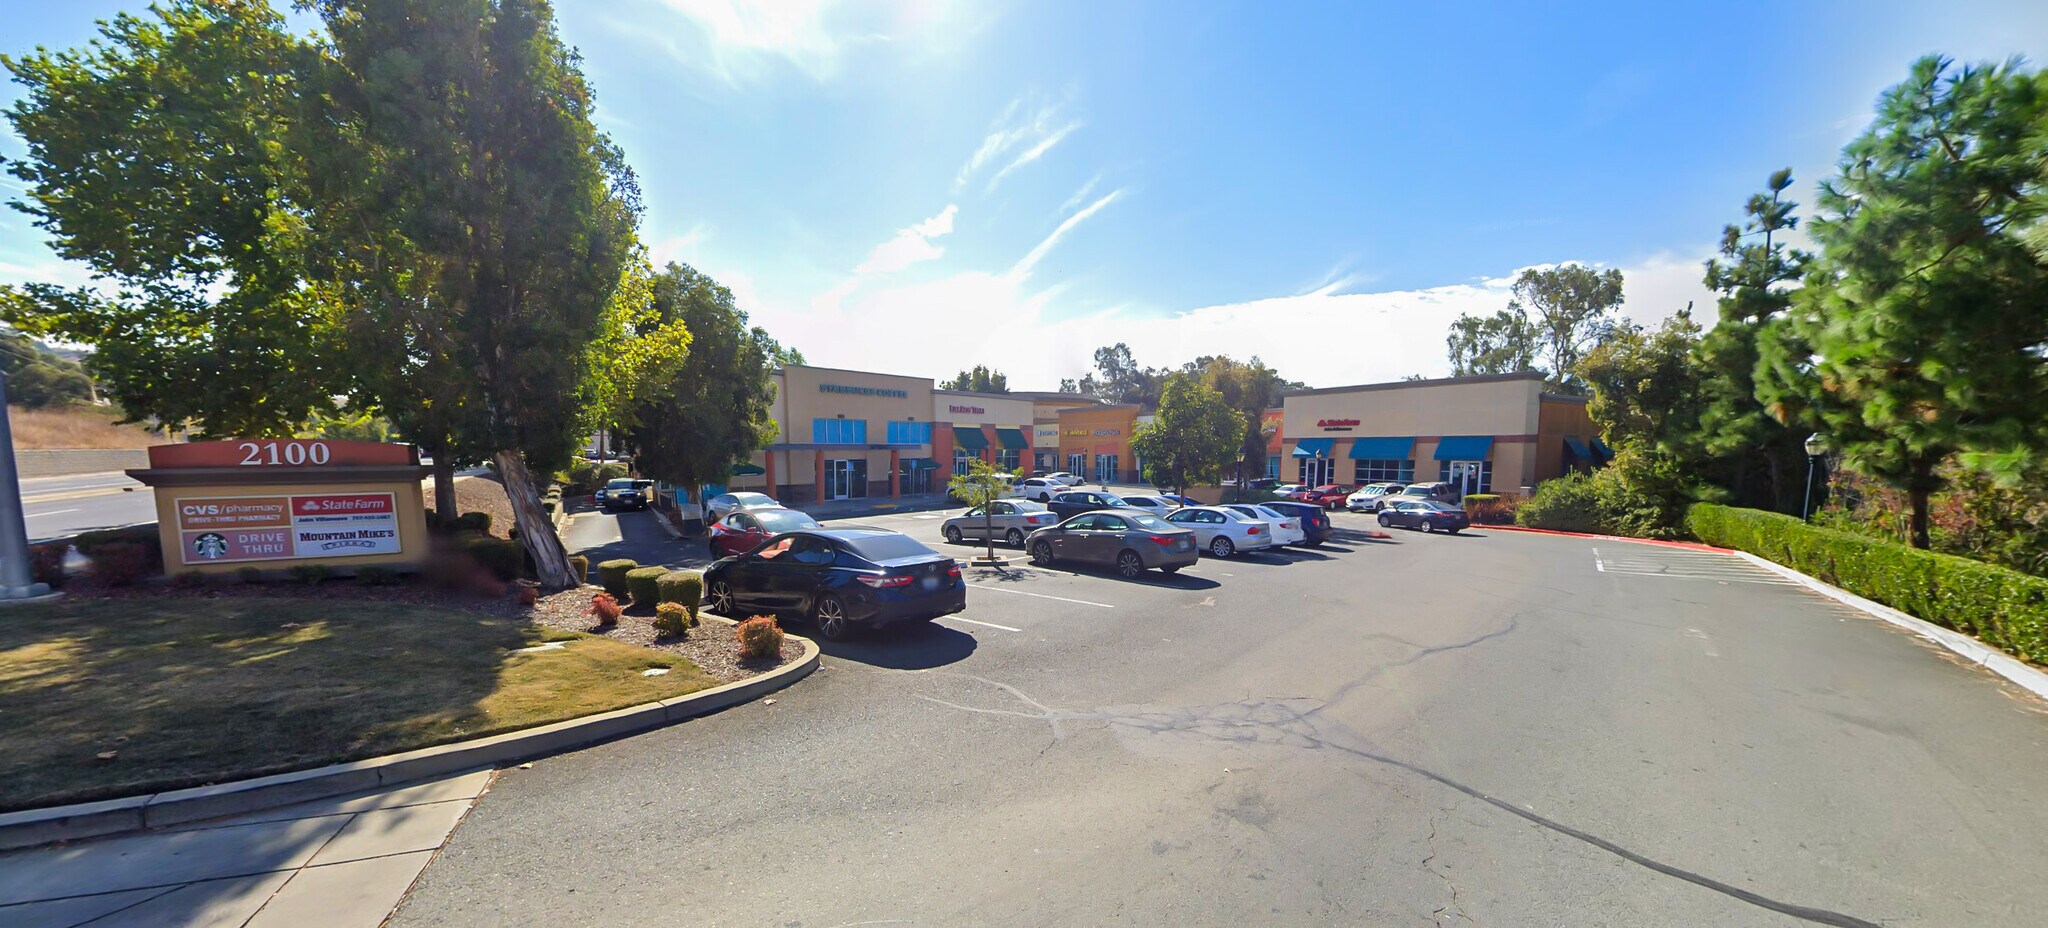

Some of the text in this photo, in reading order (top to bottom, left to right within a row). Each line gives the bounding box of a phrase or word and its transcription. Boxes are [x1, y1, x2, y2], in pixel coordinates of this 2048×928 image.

[238, 442, 330, 466] 2100
[238, 514, 281, 522] PHARMACY
[238, 532, 284, 544] DRIVE
[243, 544, 284, 554] THRU
